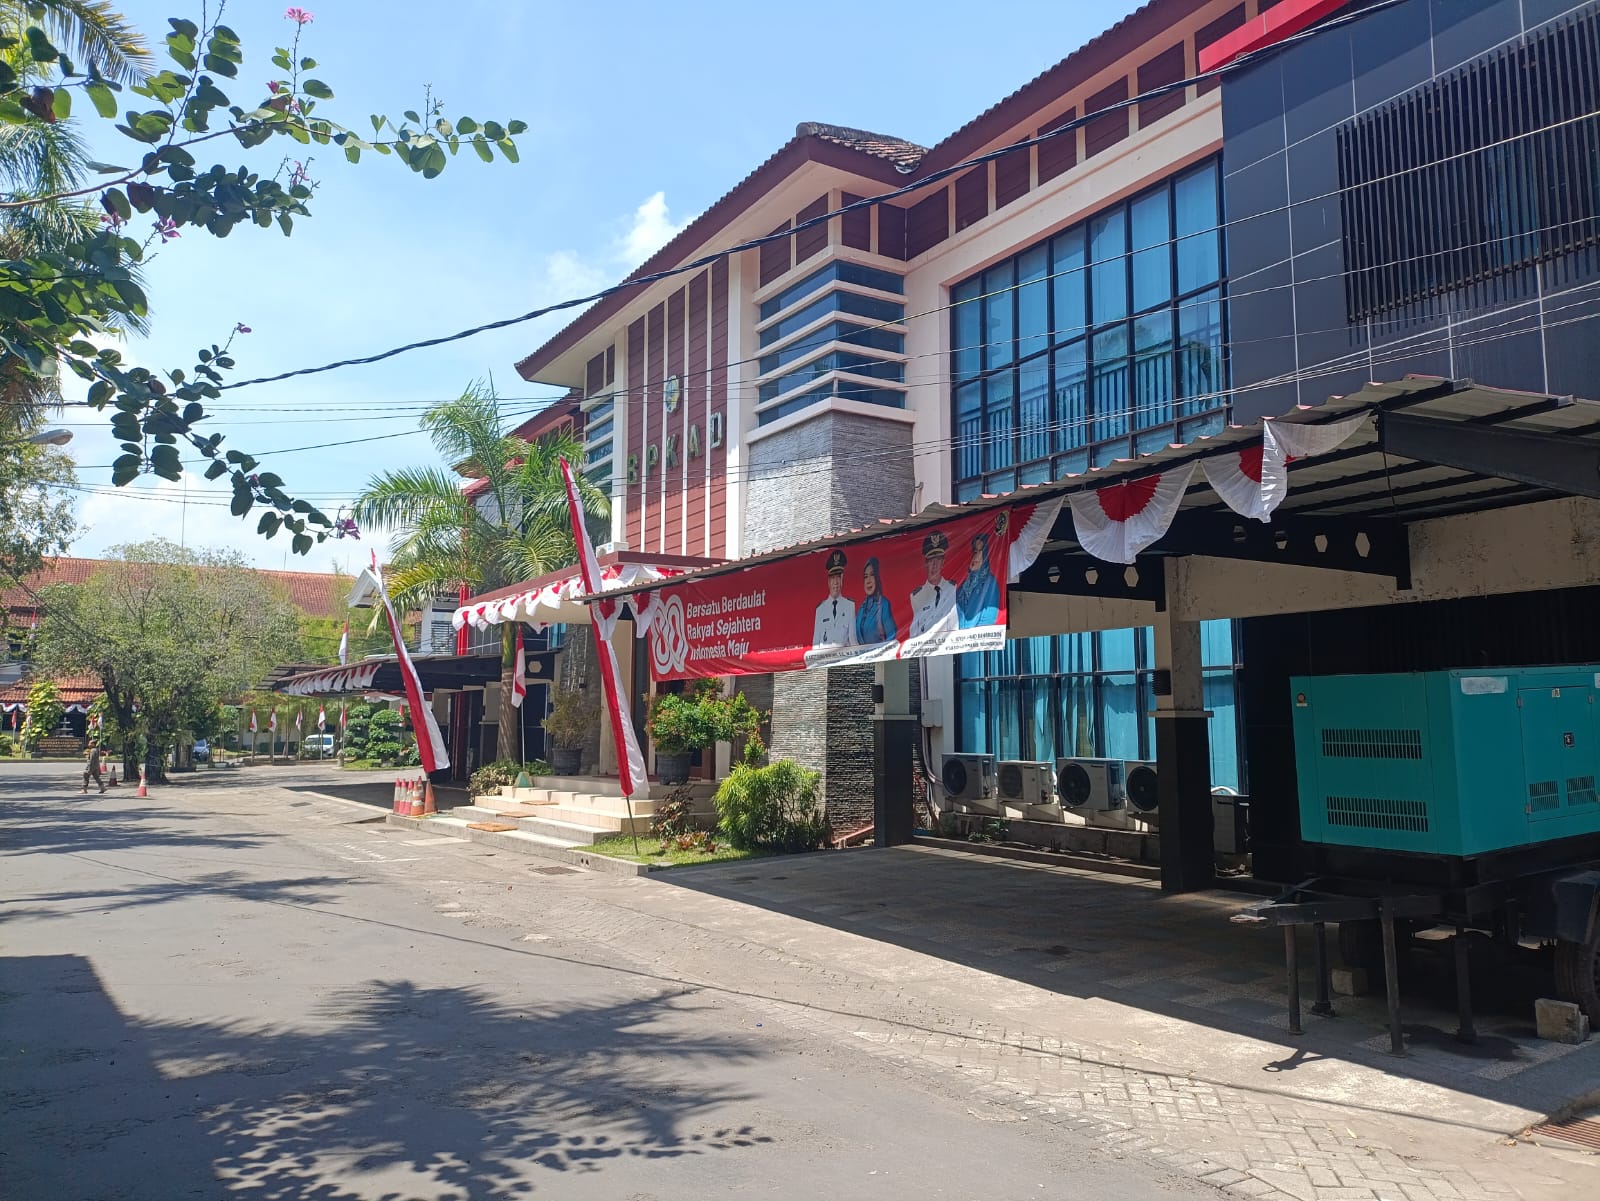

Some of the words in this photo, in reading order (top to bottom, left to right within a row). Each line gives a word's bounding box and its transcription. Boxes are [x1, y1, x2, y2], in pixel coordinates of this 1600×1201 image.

[627, 412, 722, 485] BPKAD
[687, 600, 721, 619] Bersatu
[722, 589, 766, 614] Berdaulat
[687, 620, 715, 641] Rakyat
[716, 617, 761, 639] Sejahtera
[690, 640, 726, 661] Indonesia
[727, 638, 750, 660] Maju
